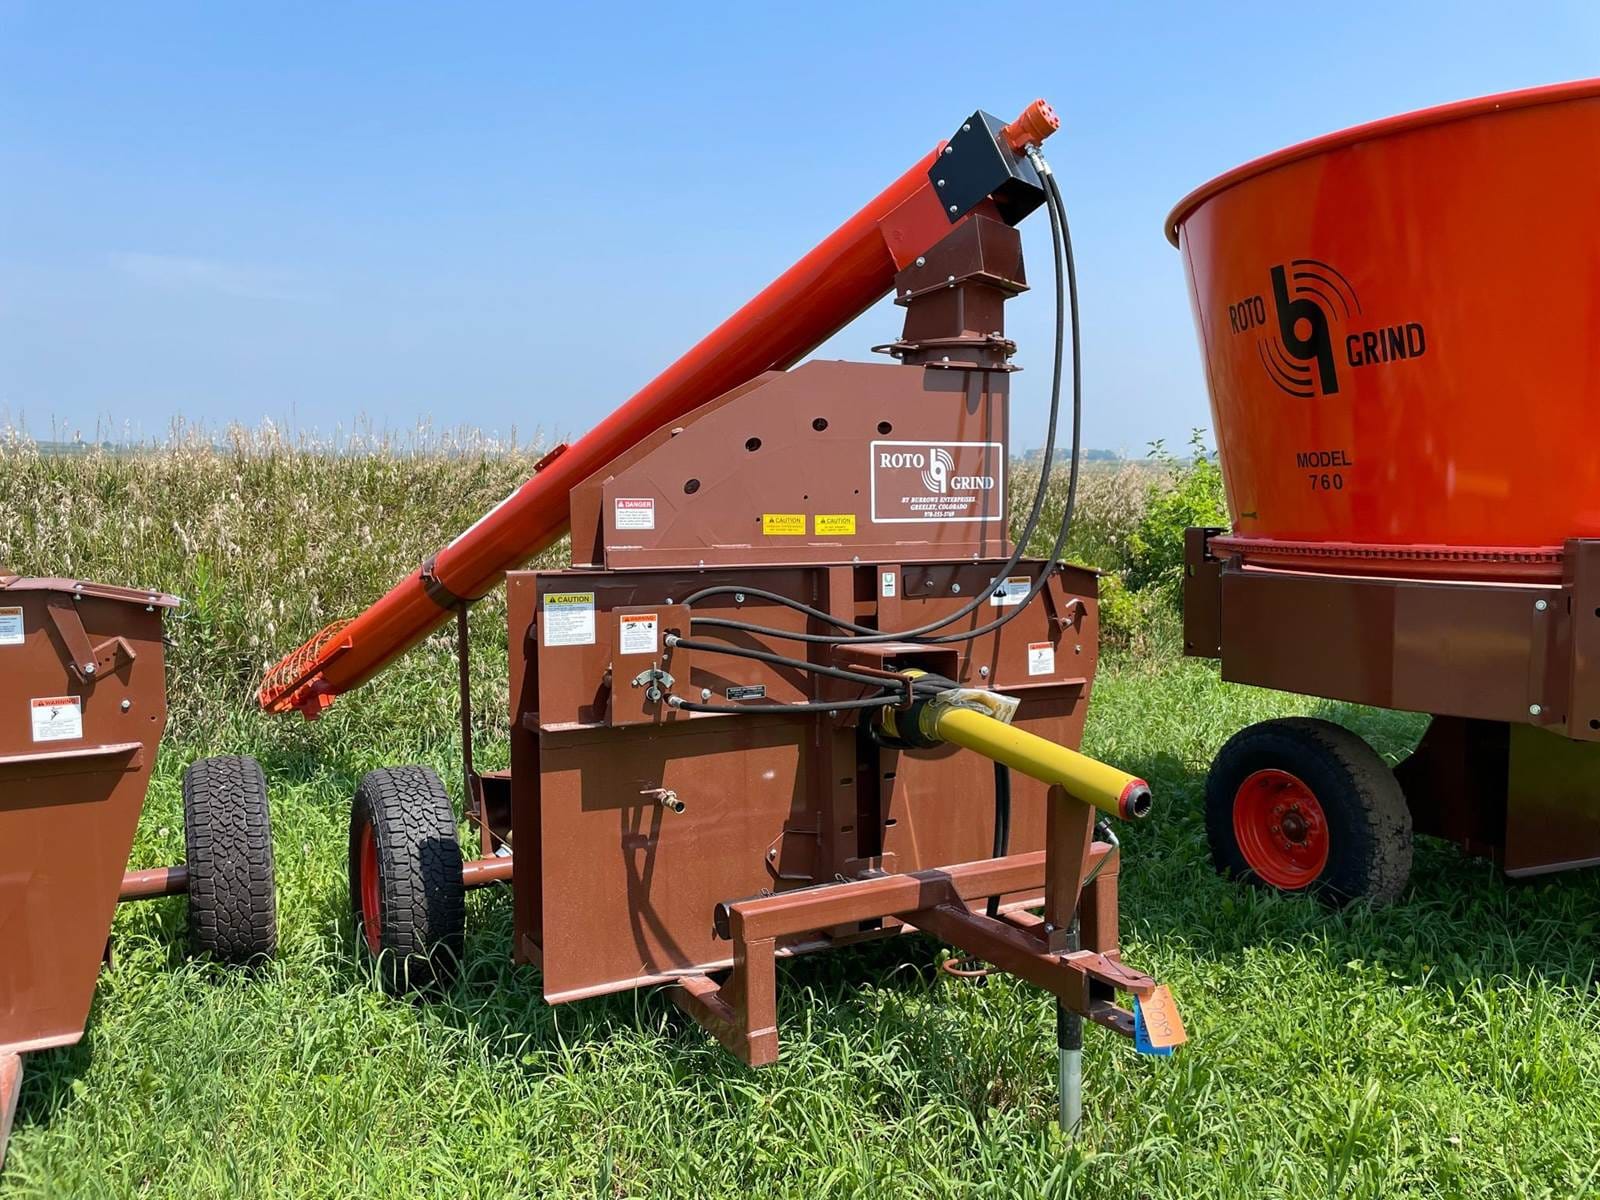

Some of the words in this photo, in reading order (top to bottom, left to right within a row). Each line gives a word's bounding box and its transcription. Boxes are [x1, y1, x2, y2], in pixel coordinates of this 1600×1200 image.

[1228, 295, 1266, 334] ROTO
[1345, 322, 1426, 367] GRIND
[879, 453, 925, 468] ROTO
[1296, 451, 1352, 468] MODEL
[950, 476, 994, 490] GRIND
[1309, 474, 1343, 490] 760
